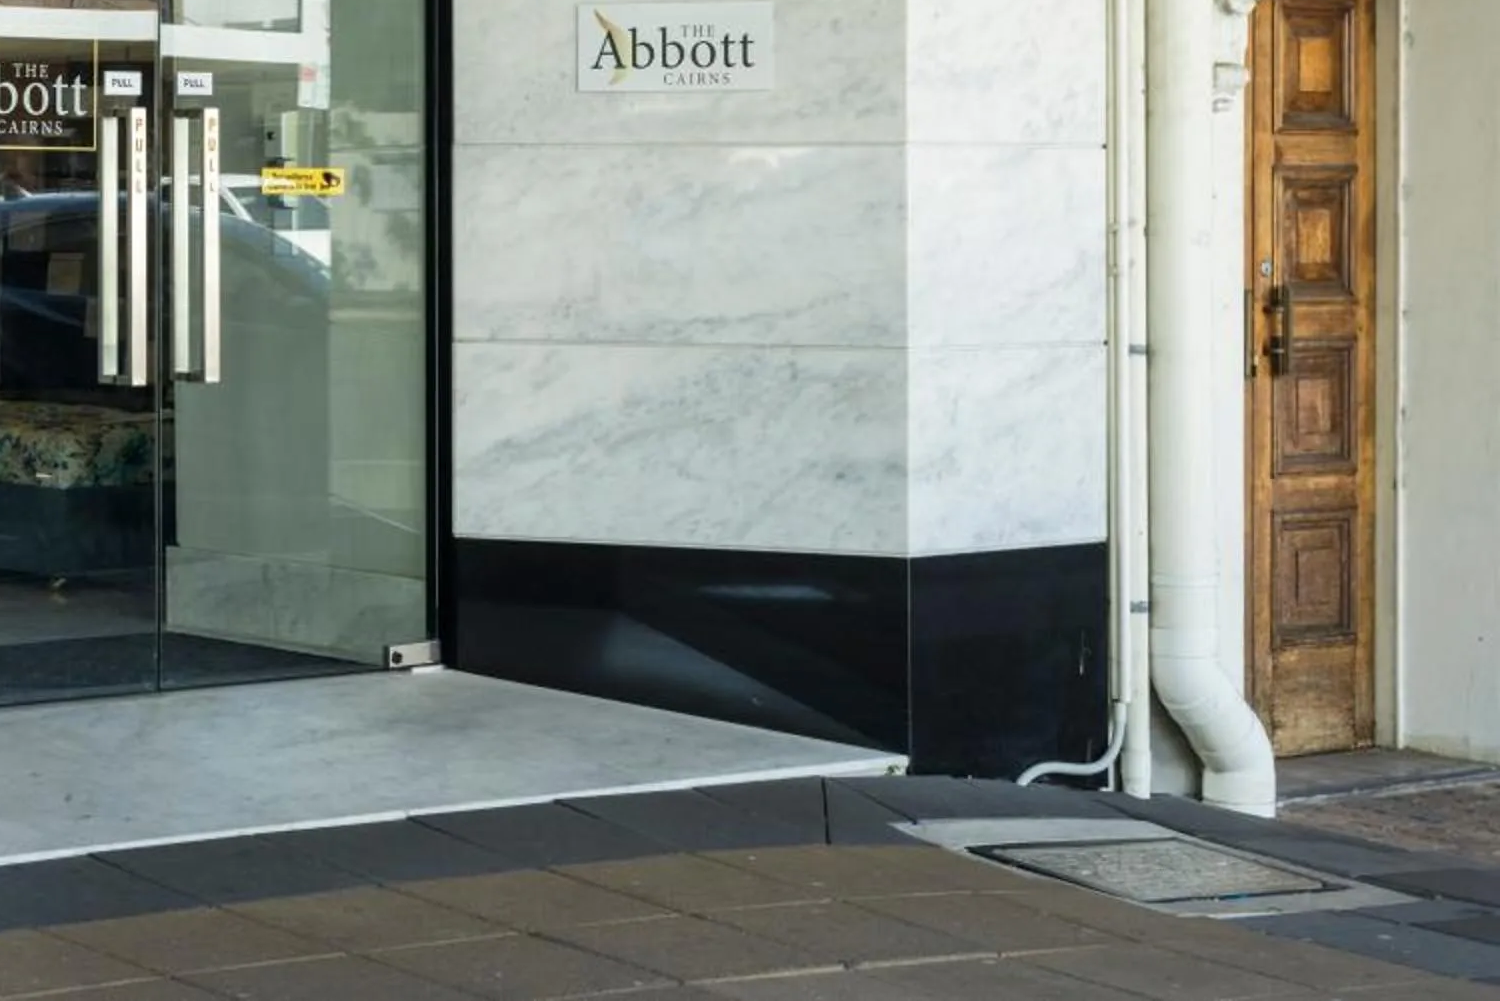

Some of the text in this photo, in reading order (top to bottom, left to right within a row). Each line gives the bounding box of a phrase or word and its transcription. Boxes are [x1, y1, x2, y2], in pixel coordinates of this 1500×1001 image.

[680, 24, 716, 39] THE
[590, 27, 755, 70] Abbott
[13, 62, 49, 79] THE
[111, 78, 134, 89] PULL
[183, 78, 205, 89] PULL
[663, 72, 731, 86] CAIRNS
[135, 118, 144, 194] PULL
